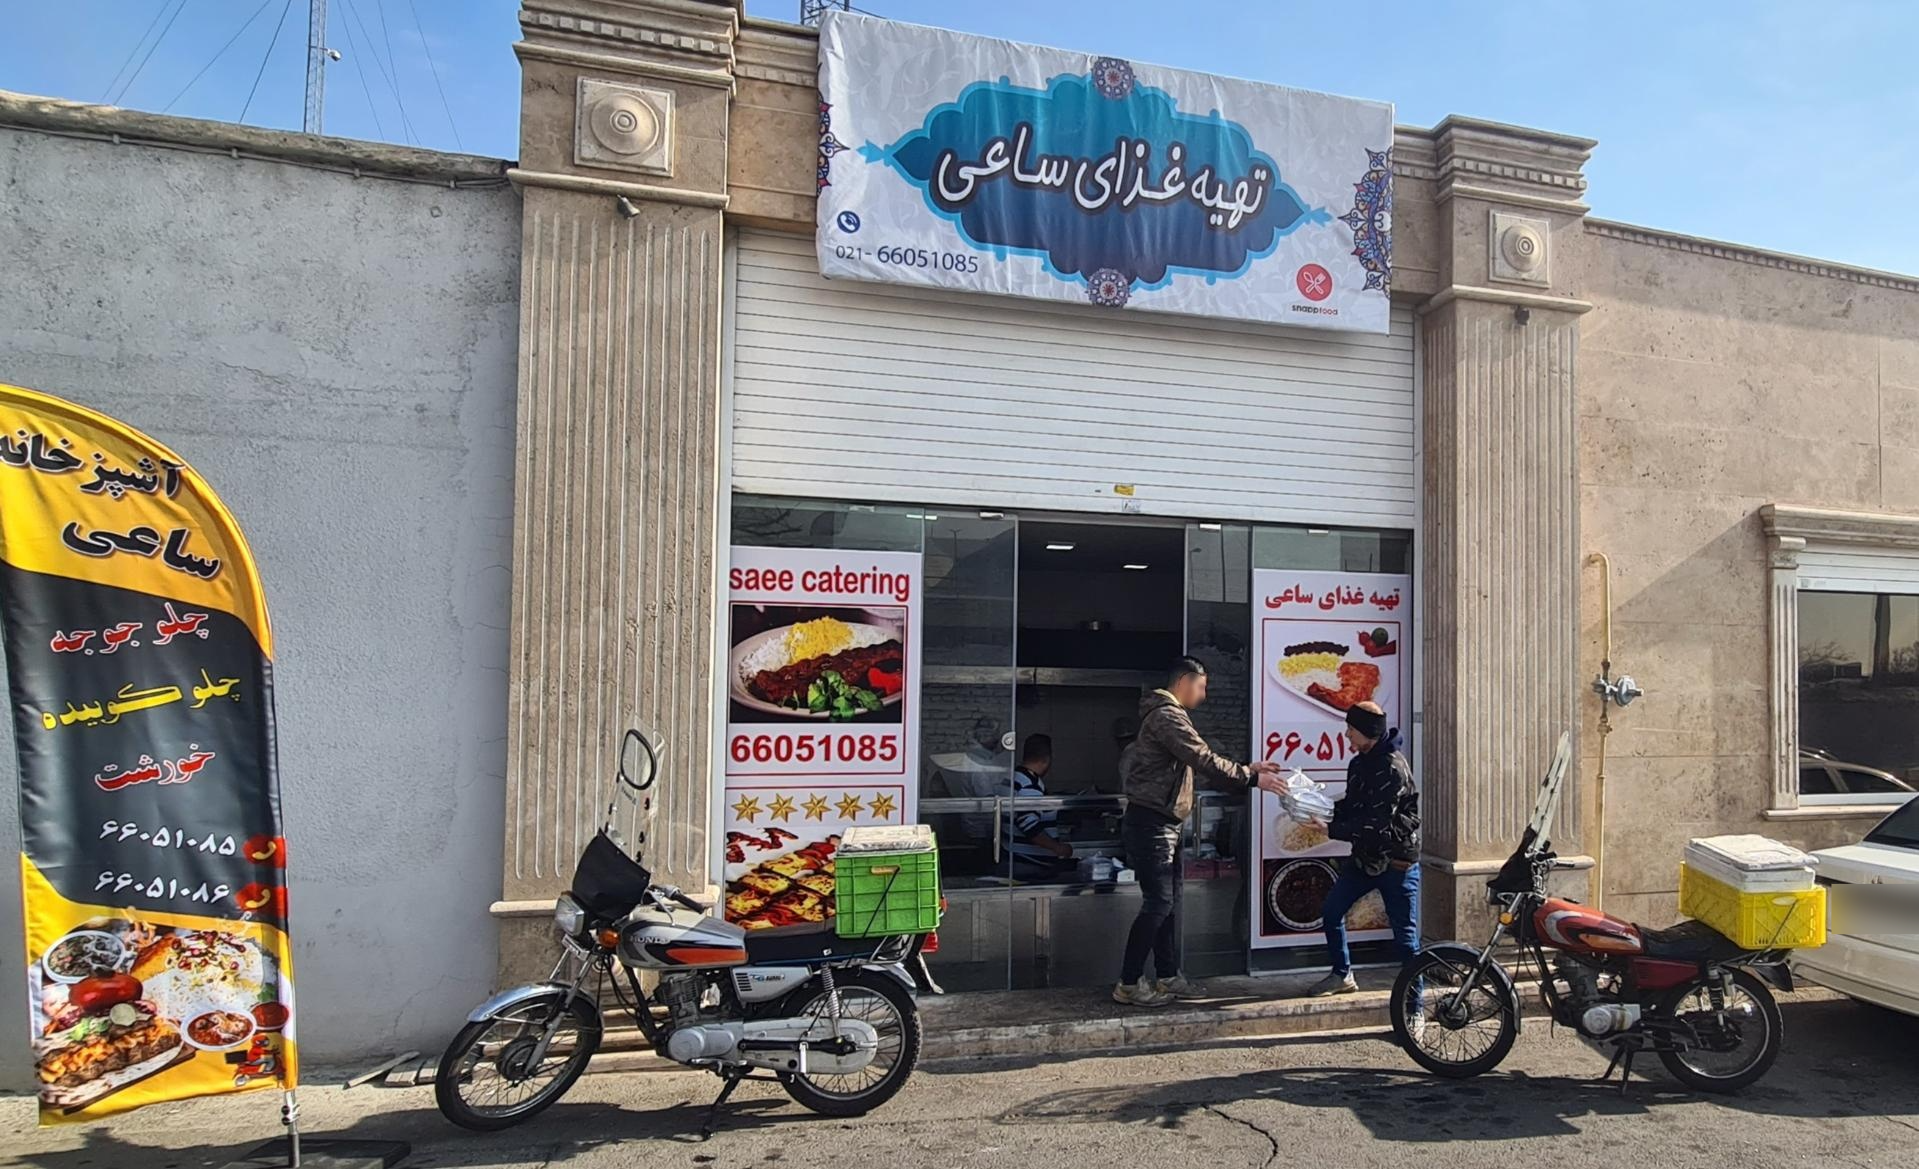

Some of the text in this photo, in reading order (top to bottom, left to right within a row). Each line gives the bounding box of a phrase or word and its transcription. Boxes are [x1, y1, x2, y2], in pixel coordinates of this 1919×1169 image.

[937, 126, 1266, 229] تهیه غذای ساعی
[835, 245, 978, 273] 021- 66051085
[61, 521, 222, 578] ساعی
[729, 566, 910, 601] saee catering
[1265, 584, 1400, 610] تهیه غذای ساعی
[152, 602, 209, 645] چلو
[41, 668, 241, 730] چلو کوبیده
[94, 743, 216, 791] خورشت
[730, 735, 898, 763] 66051085
[99, 820, 236, 857] ۶۶۰۵۱۰۸۵
[94, 871, 230, 903] ۶۶۰۵۱۰۸۶
